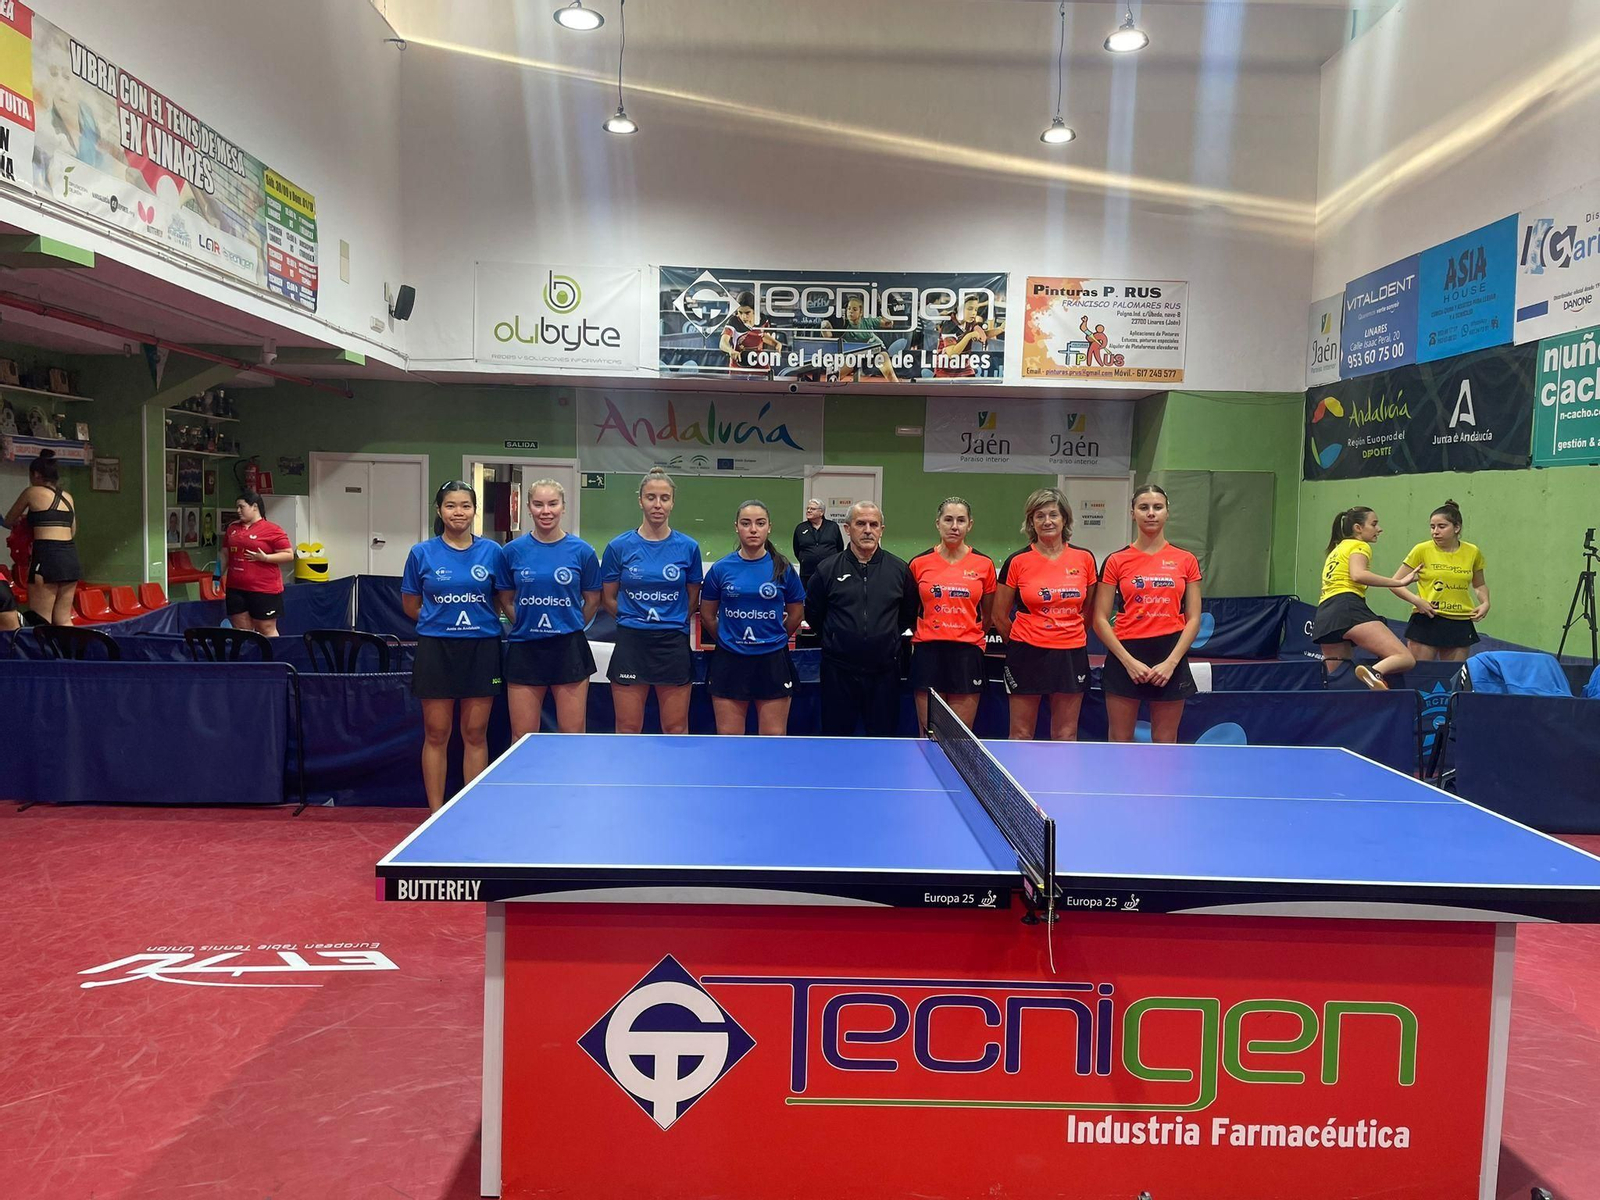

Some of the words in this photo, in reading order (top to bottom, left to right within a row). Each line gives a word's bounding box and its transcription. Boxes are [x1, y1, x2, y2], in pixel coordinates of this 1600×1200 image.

[70, 39, 117, 98] VIBRA
[119, 73, 149, 121] CON
[150, 94, 165, 125] EL
[165, 101, 200, 148] TENIS
[200, 124, 217, 159] DE
[216, 135, 247, 178] MESA
[119, 107, 143, 156] EN
[147, 123, 216, 195] LINARES
[1444, 244, 1487, 291] ASIA
[1034, 284, 1098, 297] Pinturas
[1103, 286, 1118, 298] P.
[1124, 287, 1162, 298] RUS
[1347, 274, 1415, 311] VITALDENT
[1443, 282, 1487, 303] HOUSE
[718, 278, 995, 333] Tecnigen
[1061, 300, 1109, 308] FRANCISCO
[1112, 301, 1162, 309] PALOMARES
[494, 315, 621, 351] olibyte
[1350, 342, 1363, 351] Calle
[1364, 338, 1378, 349] Isaac
[1393, 330, 1400, 341] 20
[1364, 323, 1388, 338] LINARES
[747, 351, 781, 367] con
[787, 349, 804, 367] el
[811, 349, 885, 372] deporte
[892, 350, 914, 368] de
[920, 350, 991, 369] Linares
[1312, 337, 1338, 366] Jaén
[1347, 352, 1363, 369] 953
[1364, 349, 1376, 365] 60
[1378, 346, 1389, 362] 75
[1392, 342, 1404, 358] 00
[1543, 332, 1600, 373] nuñ
[1136, 369, 1149, 377] 617
[1149, 370, 1162, 378] 249
[1163, 370, 1177, 378] 577
[1348, 389, 1412, 428] Andalucía
[594, 397, 806, 451] Andalucía
[961, 433, 1010, 455] Jaén
[1050, 434, 1099, 456] Jaén
[1347, 436, 1365, 449] Región
[1432, 435, 1451, 445] Junta
[1558, 437, 1586, 451] gestión
[1589, 437, 1595, 447] &
[1362, 446, 1392, 459] DEPORTE
[397, 879, 481, 901] BUTTERFLY
[924, 892, 960, 905] Europa
[962, 893, 975, 904] 25
[1066, 896, 1103, 908] Europa
[1105, 897, 1118, 907] 25
[146, 945, 194, 953] Union
[257, 942, 298, 950] Table
[304, 942, 381, 950] European
[700, 975, 1418, 1112] Tecnigen
[1067, 1114, 1201, 1146] Industria
[1211, 1116, 1411, 1149] Farmacéutica
